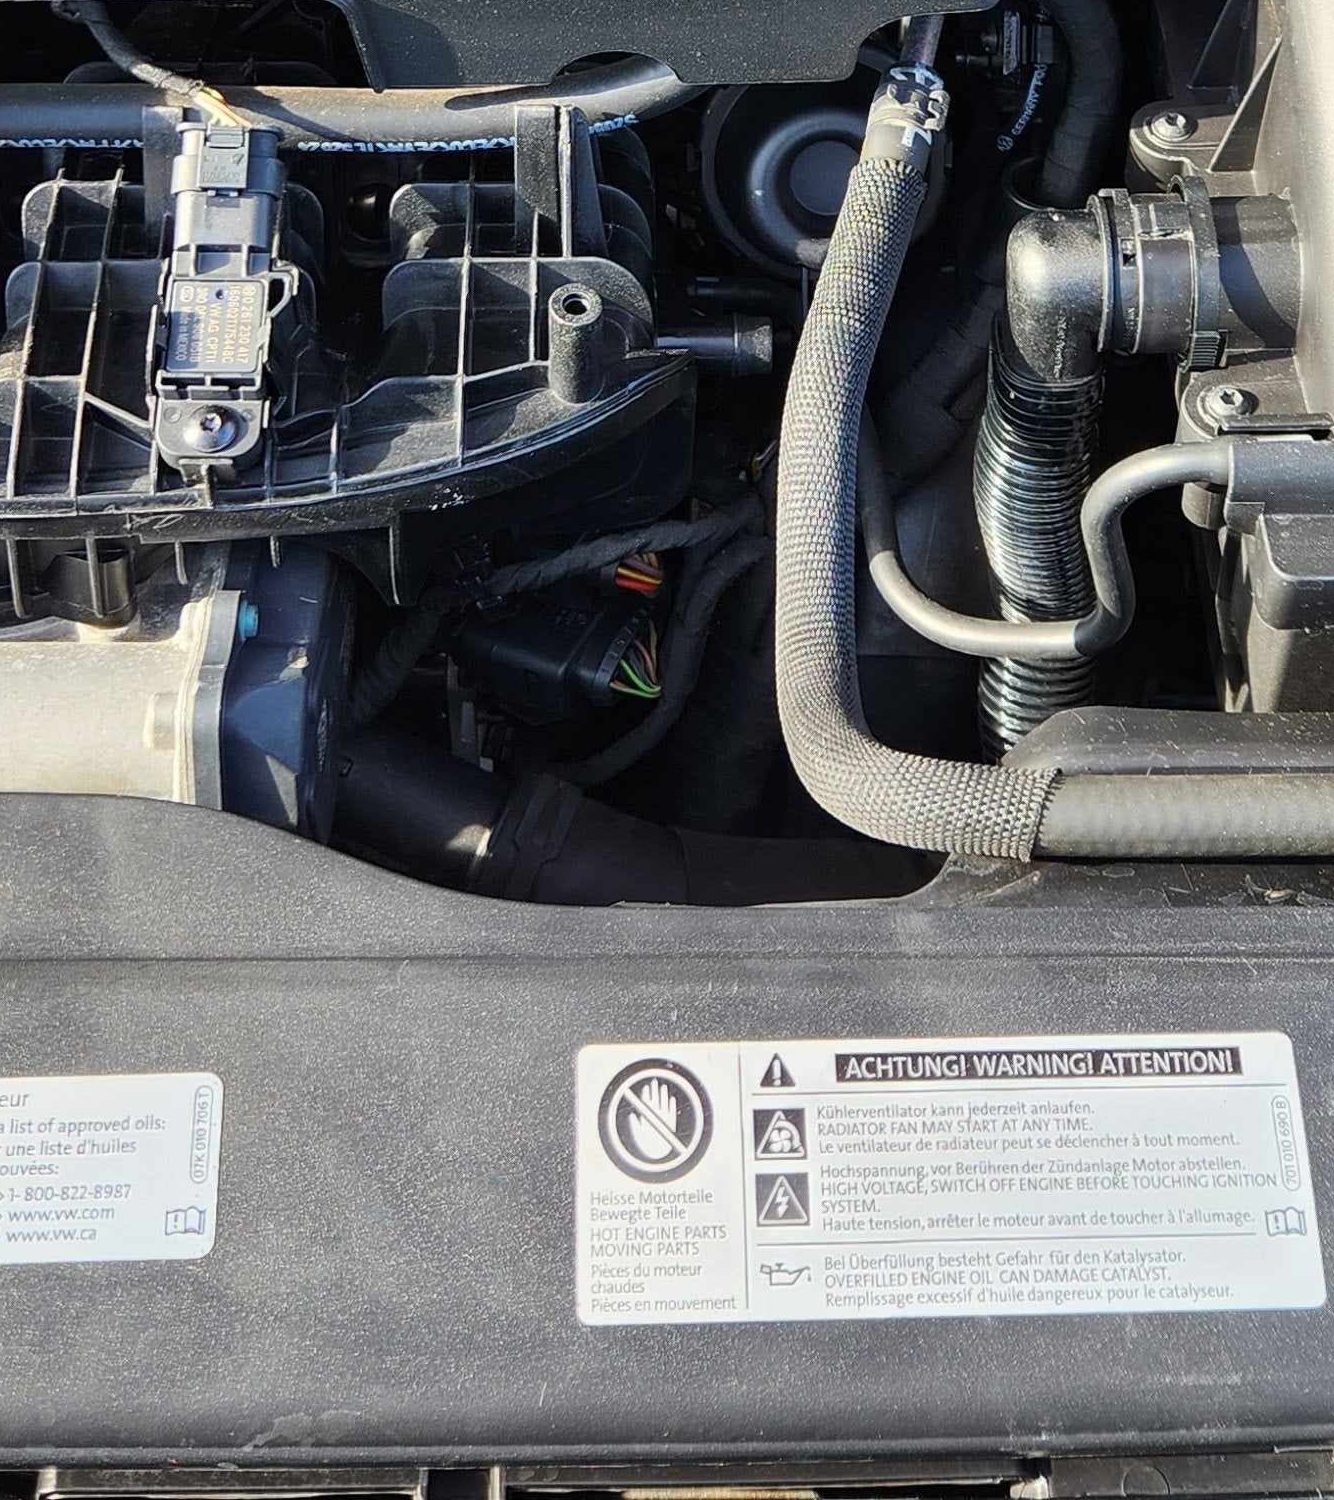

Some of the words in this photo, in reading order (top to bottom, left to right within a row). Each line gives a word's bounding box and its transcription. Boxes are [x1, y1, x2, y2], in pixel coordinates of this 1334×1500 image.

[240, 305, 253, 322] 261
[238, 324, 251, 343] 230
[236, 346, 249, 364] 417
[846, 1055, 967, 1080] ACHTUNG!
[972, 1052, 1094, 1077] WARNING!
[1101, 1050, 1234, 1075] ATTENTION!
[197, 1102, 209, 1125] 706
[817, 1103, 927, 1120] Kühlerventilator
[930, 1102, 968, 1120] kann
[967, 1101, 1028, 1120] jederzeit
[1030, 1099, 1095, 1116] anlaufen.
[9, 1118, 34, 1134] list
[36, 1117, 56, 1134] of
[57, 1115, 131, 1138] approved
[134, 1114, 166, 1130] oils:
[818, 1121, 887, 1136] RADIATOR
[890, 1121, 918, 1135] FAN
[922, 1120, 954, 1135] MAY
[957, 1116, 998, 1133] START
[1001, 1118, 1019, 1133] AT
[1021, 1118, 1051, 1133] ANY
[1052, 1117, 1093, 1132] TIME.
[5, 1145, 36, 1157] une
[39, 1140, 73, 1156] liste
[76, 1137, 137, 1155] d'huiles
[195, 1128, 207, 1151] 010
[819, 1140, 834, 1154] Le
[836, 1138, 912, 1153] ventilateur
[915, 1137, 933, 1152] de
[936, 1136, 999, 1151] radiateur
[1002, 1135, 1034, 1154] peut
[1036, 1138, 1052, 1149] se
[1054, 1132, 1129, 1149] déclencher
[1132, 1132, 1140, 1147] à
[1143, 1133, 1173, 1147] tout
[1177, 1132, 1241, 1147] moment.
[193, 1153, 205, 1178] 07K
[820, 1163, 929, 1183] Hochspannung,
[930, 1164, 953, 1176] vor
[956, 1160, 1019, 1175] Berühren
[1021, 1159, 1045, 1174] der
[1047, 1158, 1130, 1178] Zündanlage
[1132, 1158, 1176, 1172] Motor
[1179, 1155, 1246, 1172] abstellen.
[821, 1181, 858, 1196] HIGH
[861, 1177, 929, 1196] VOLTAGE,
[930, 1178, 986, 1193] SWITCH
[989, 1177, 1016, 1192] OFF
[1019, 1176, 1074, 1191] ENGINE
[1076, 1173, 1130, 1190] BEFORE
[1131, 1174, 1209, 1190] TOUCHING
[1212, 1172, 1277, 1188] IGNITION
[590, 1191, 636, 1206] Heisse
[639, 1188, 713, 1205] Motorteile
[821, 1198, 881, 1214] SYSTEM.
[8, 1207, 115, 1222] www.vw.com
[590, 1206, 651, 1225] Bewegte
[653, 1204, 687, 1220] Teile
[823, 1217, 865, 1232] Haute
[868, 1215, 925, 1231] tension,
[927, 1213, 975, 1229] arrêter
[977, 1212, 990, 1228] le
[993, 1212, 1045, 1228] moteur
[1048, 1210, 1088, 1226] avant
[1089, 1210, 1108, 1226] de
[1110, 1209, 1164, 1226] toucher
[1167, 1208, 1175, 1224] à
[1178, 1208, 1255, 1228] l'allumage.
[6, 1228, 97, 1243] www.vw.ca
[590, 1227, 621, 1242] HOT
[625, 1225, 680, 1241] ENGINE
[684, 1224, 727, 1240] PARTS
[590, 1242, 652, 1258] MOVING
[657, 1241, 700, 1256] PARTS
[591, 1263, 631, 1279] Pièces
[633, 1262, 650, 1278] du
[653, 1262, 703, 1277] moteur
[824, 1255, 845, 1271] Bei
[849, 1253, 935, 1275] Überfüllung
[938, 1250, 992, 1268] besteht
[995, 1250, 1044, 1267] Gefahr
[1048, 1250, 1071, 1265] für
[1073, 1248, 1100, 1265] den
[1103, 1248, 1186, 1269] Katalysator.
[591, 1278, 645, 1294] chaudes
[824, 1272, 908, 1289] OVERFILLED
[911, 1269, 966, 1286] ENGINE
[969, 1269, 994, 1285] OIL
[999, 1268, 1029, 1284] CAN
[1033, 1267, 1098, 1284] DAMAGE
[1101, 1263, 1172, 1282] CATALYST.
[591, 1296, 632, 1313] Pièces
[634, 1300, 651, 1312] en
[654, 1295, 737, 1311] mouvement
[825, 1290, 914, 1311] Remplissage
[917, 1287, 974, 1304] excessif
[976, 1286, 1025, 1303] d'huile
[1027, 1285, 1103, 1306] dangereux
[1107, 1287, 1140, 1304] pour
[1143, 1283, 1156, 1299] le
[1159, 1282, 1234, 1303] catalyseur.
